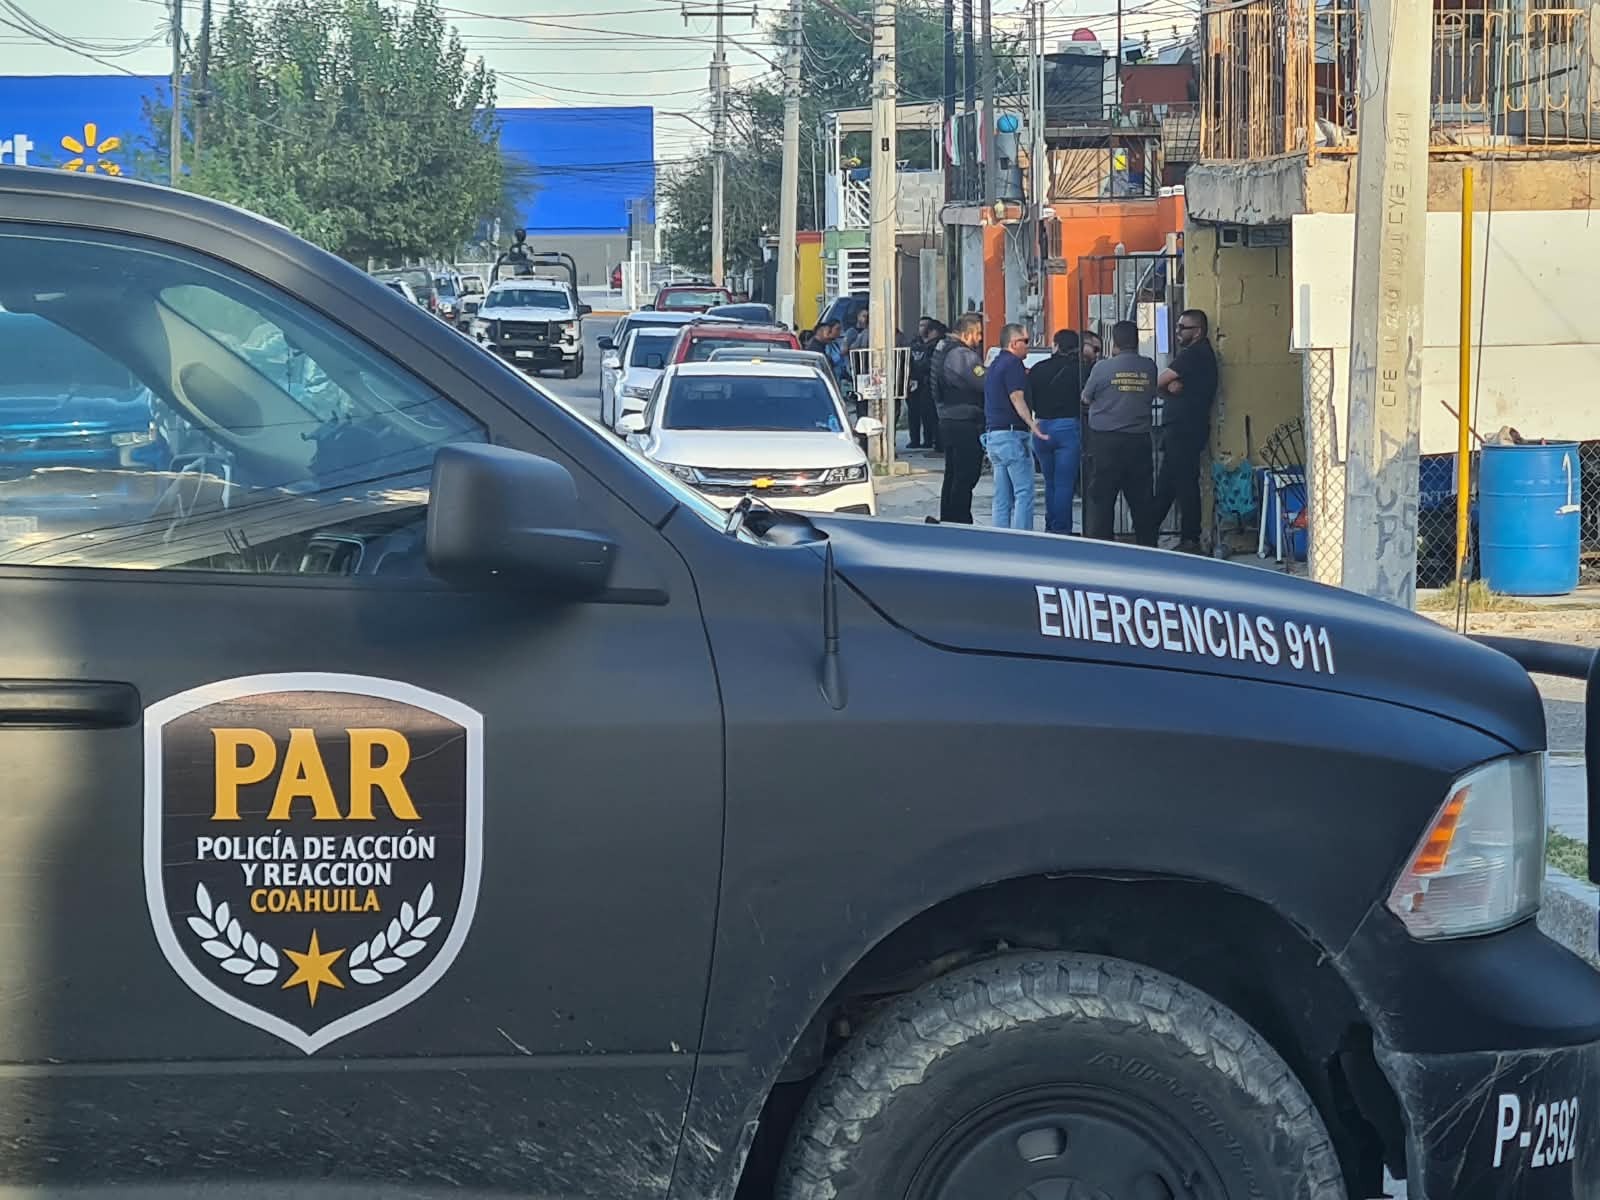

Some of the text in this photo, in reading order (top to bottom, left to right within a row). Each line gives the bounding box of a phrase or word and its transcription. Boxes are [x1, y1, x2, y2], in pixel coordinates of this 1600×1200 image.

[1388, 183, 1407, 225] CYE
[1382, 369, 1398, 407] CFE
[1034, 585, 1335, 675] EMERGENCIAS 911
[210, 727, 422, 821] PAR
[196, 829, 435, 861] POLICÍA DE ACCIÓN
[241, 855, 392, 887] Y REACCIÓN
[249, 888, 381, 913] COAHUILA
[1493, 1094, 1579, 1168] P-2592
